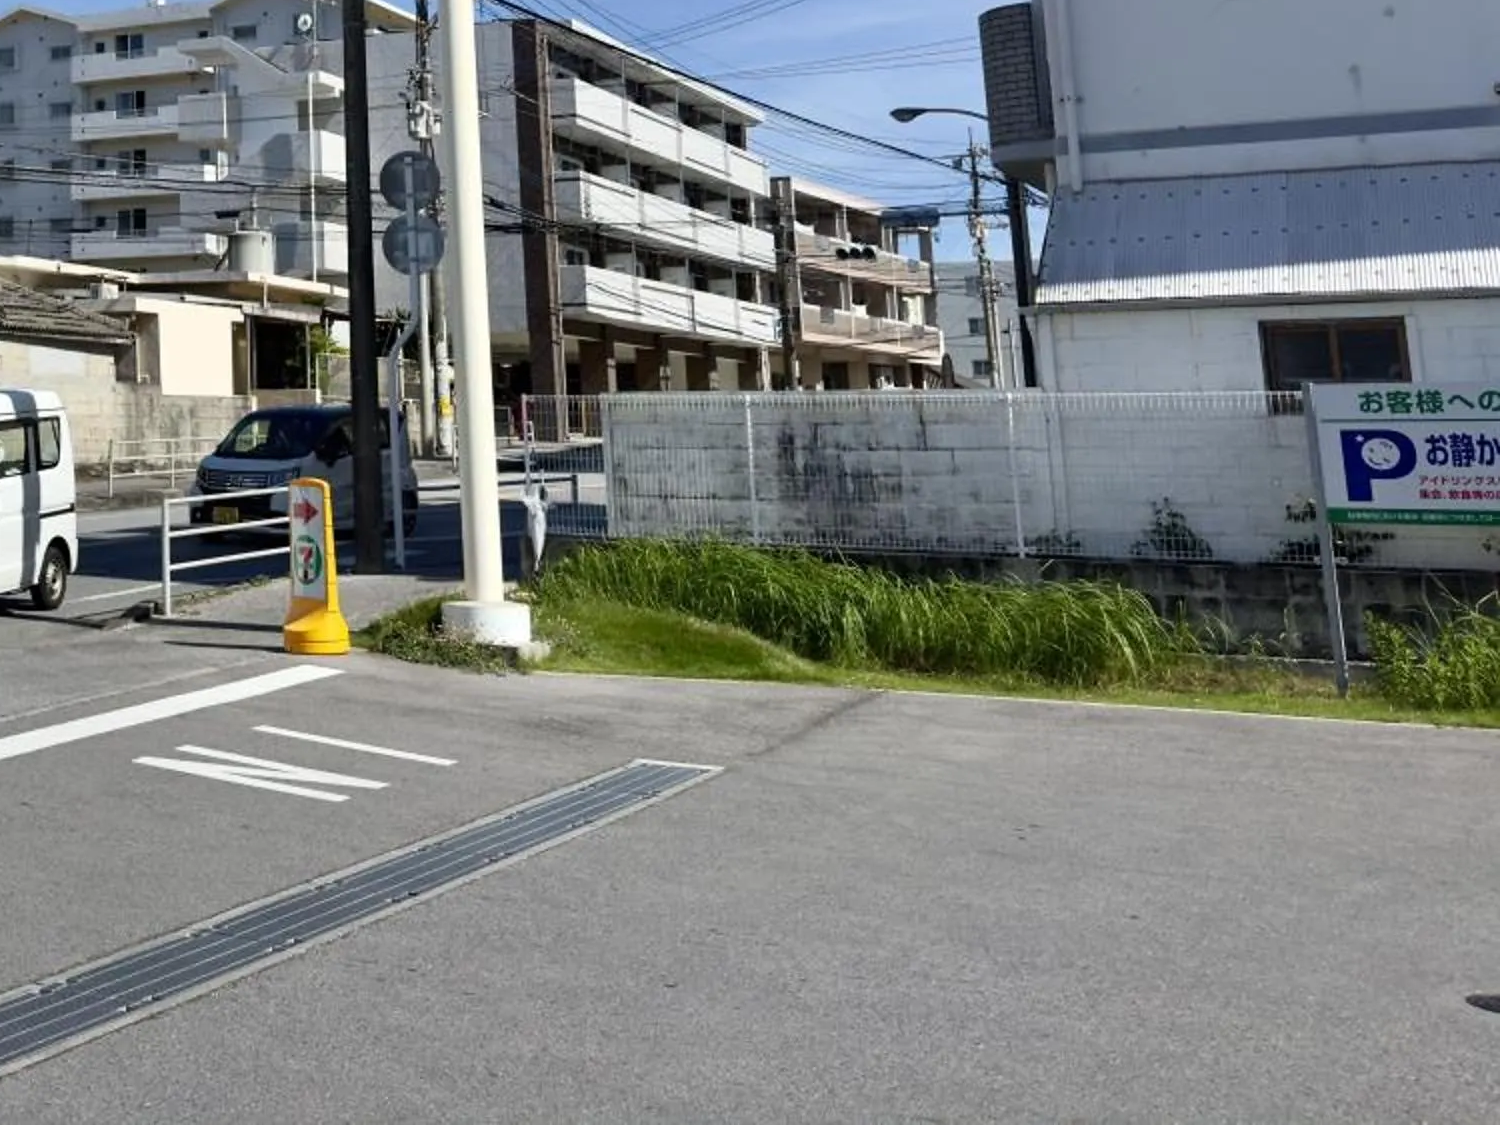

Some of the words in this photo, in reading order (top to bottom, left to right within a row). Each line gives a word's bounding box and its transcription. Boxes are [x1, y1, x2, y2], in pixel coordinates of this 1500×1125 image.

[1358, 389, 1500, 414] お客様への
[1340, 430, 1417, 502] P
[1419, 475, 1500, 486] アイドリングス
[132, 724, 459, 803] IN
